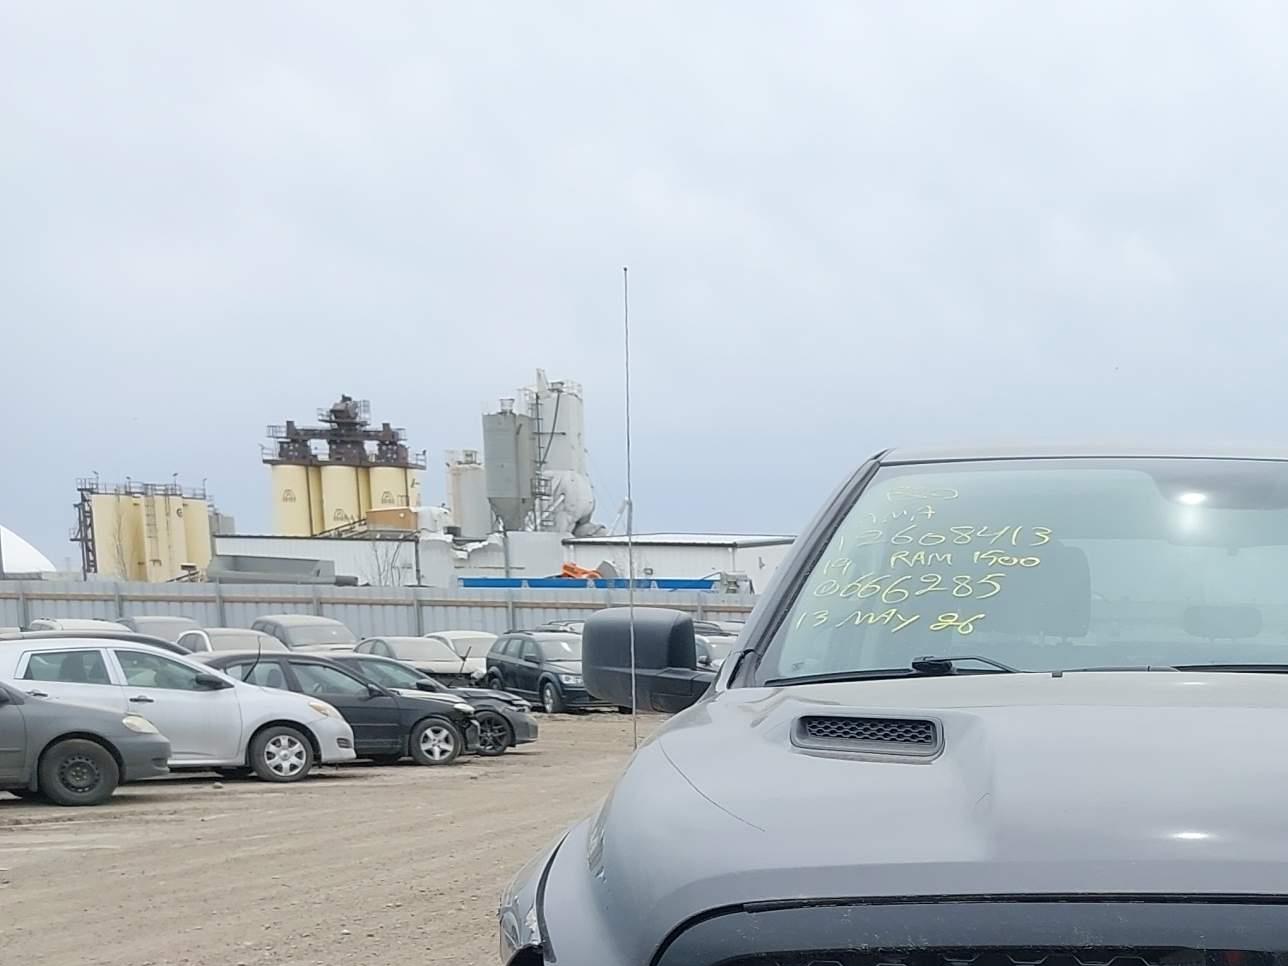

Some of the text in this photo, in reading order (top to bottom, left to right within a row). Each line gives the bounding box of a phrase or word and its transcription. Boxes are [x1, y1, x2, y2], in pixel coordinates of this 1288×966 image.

[838, 524, 1053, 551] 12608413
[890, 550, 953, 568] RAM
[973, 550, 1041, 568] 1500
[794, 608, 986, 635] 13 MAY 26
